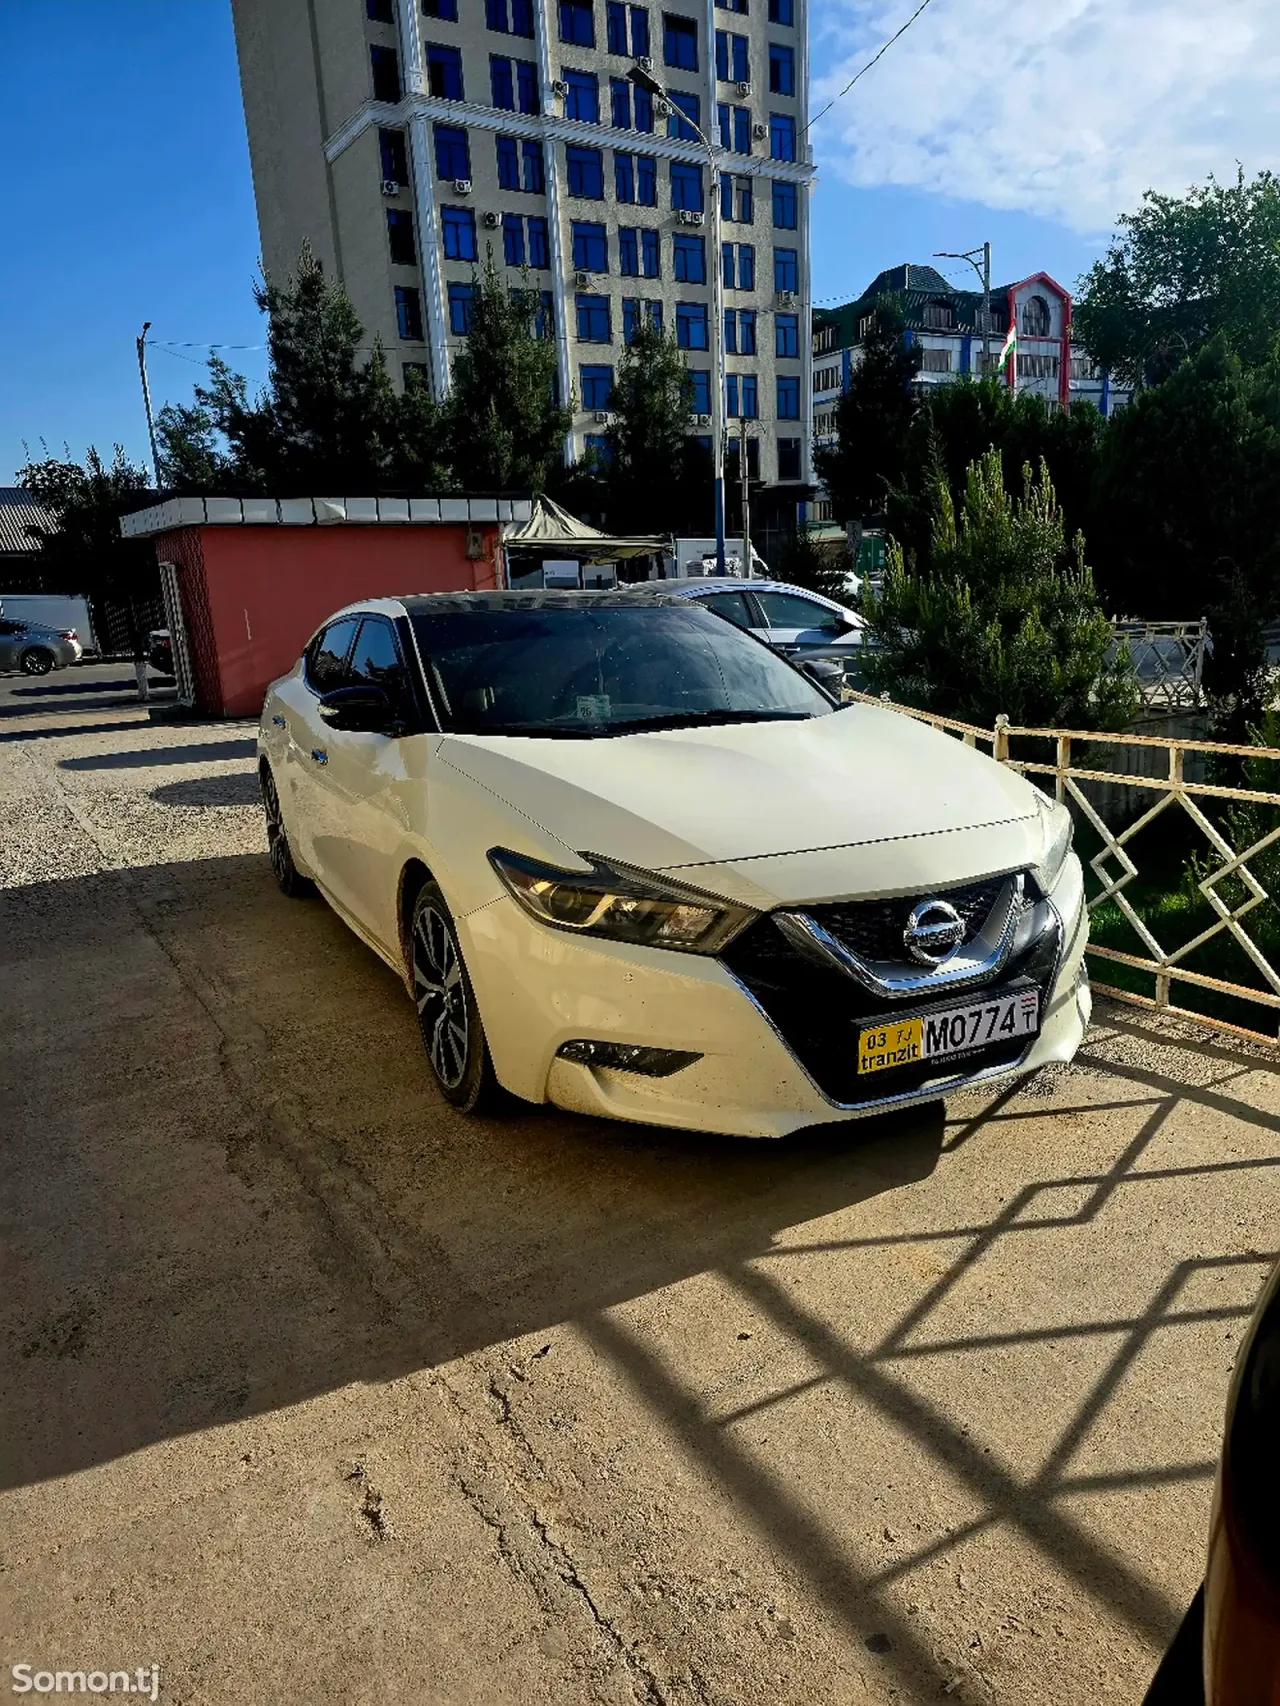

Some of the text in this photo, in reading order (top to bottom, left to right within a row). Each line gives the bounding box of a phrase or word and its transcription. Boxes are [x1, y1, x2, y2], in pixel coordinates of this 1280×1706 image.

[1022, 1010, 1035, 1030] T
[867, 1033, 887, 1050] 03
[861, 1043, 919, 1070] tranzit
